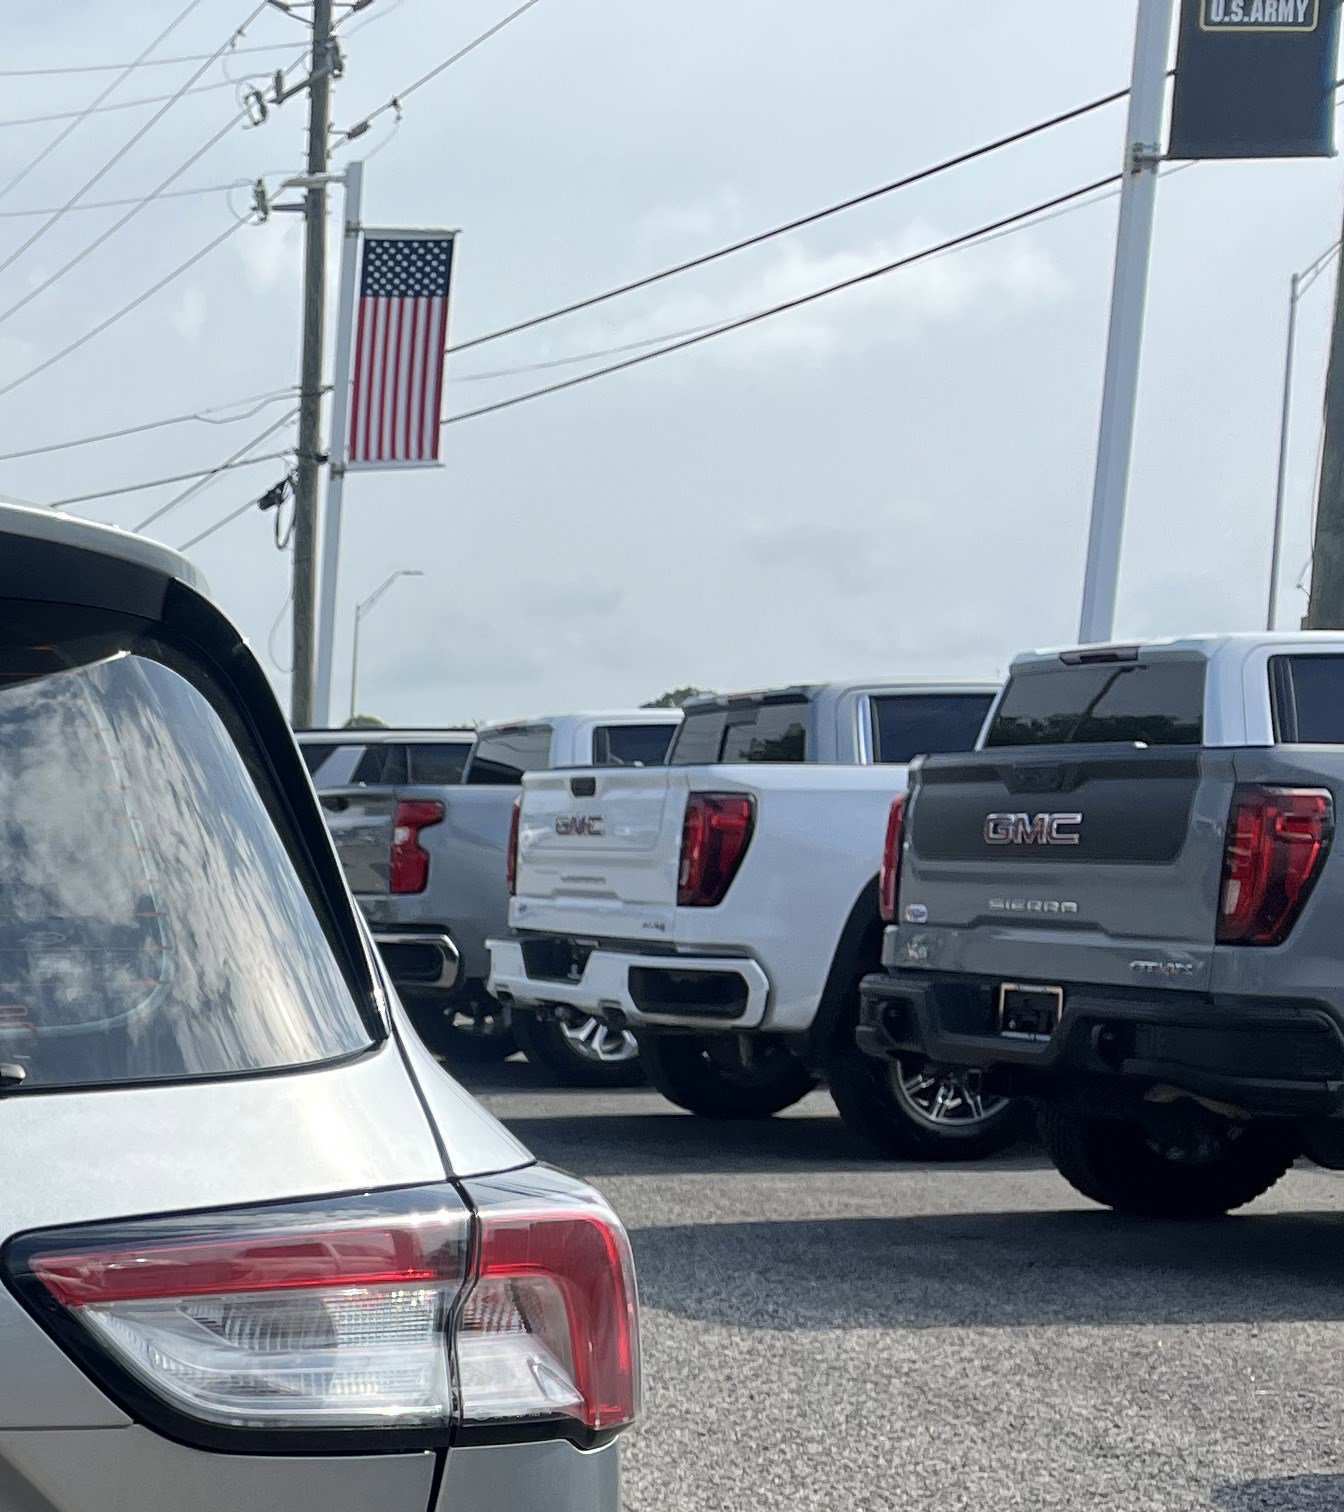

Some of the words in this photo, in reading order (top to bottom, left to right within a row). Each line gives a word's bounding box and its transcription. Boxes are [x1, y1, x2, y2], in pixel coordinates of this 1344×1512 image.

[555, 815, 605, 836] GMC
[983, 812, 1083, 845] GMC
[988, 899, 1079, 914] SIERRA
